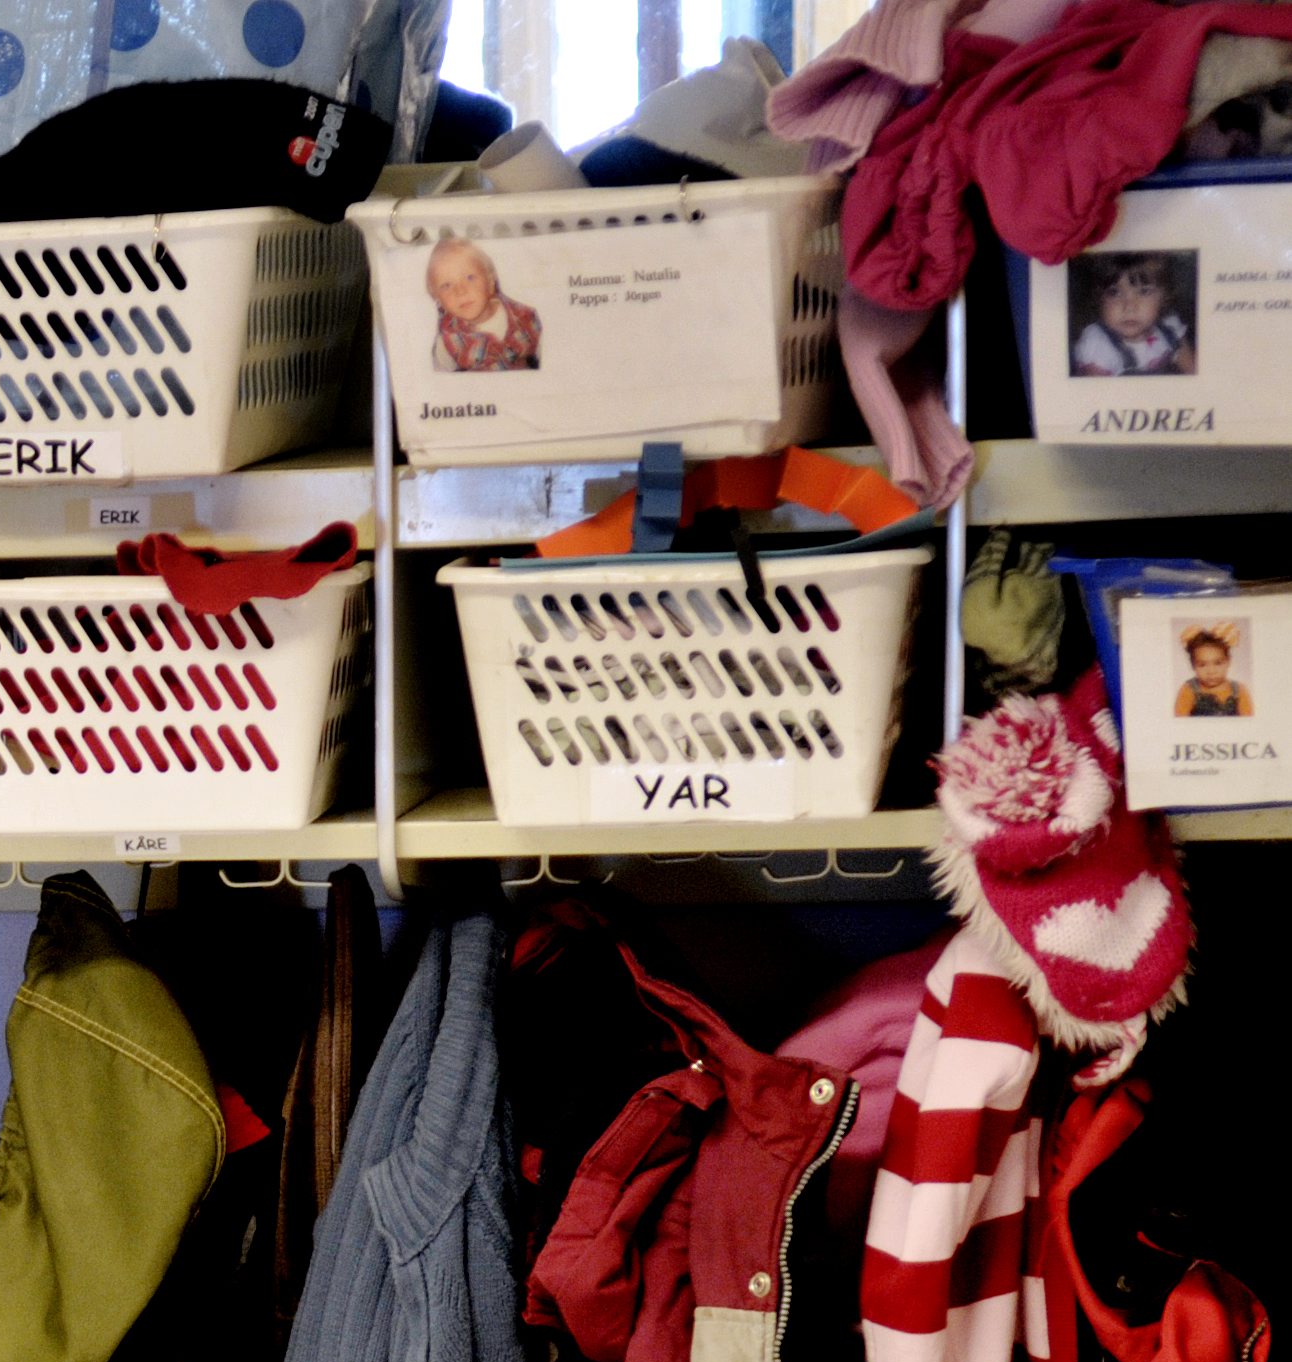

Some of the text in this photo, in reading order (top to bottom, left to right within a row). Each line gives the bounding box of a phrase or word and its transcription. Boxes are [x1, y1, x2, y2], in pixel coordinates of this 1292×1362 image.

[569, 267, 680, 287] Mamma: Natalia
[420, 401, 497, 420] Jonatan
[1081, 407, 1216, 432] ANDREA
[99, 510, 140, 524] ERIK
[1170, 742, 1278, 761] JESSICA
[634, 774, 731, 810] YAR
[124, 835, 168, 851] KÅRE
